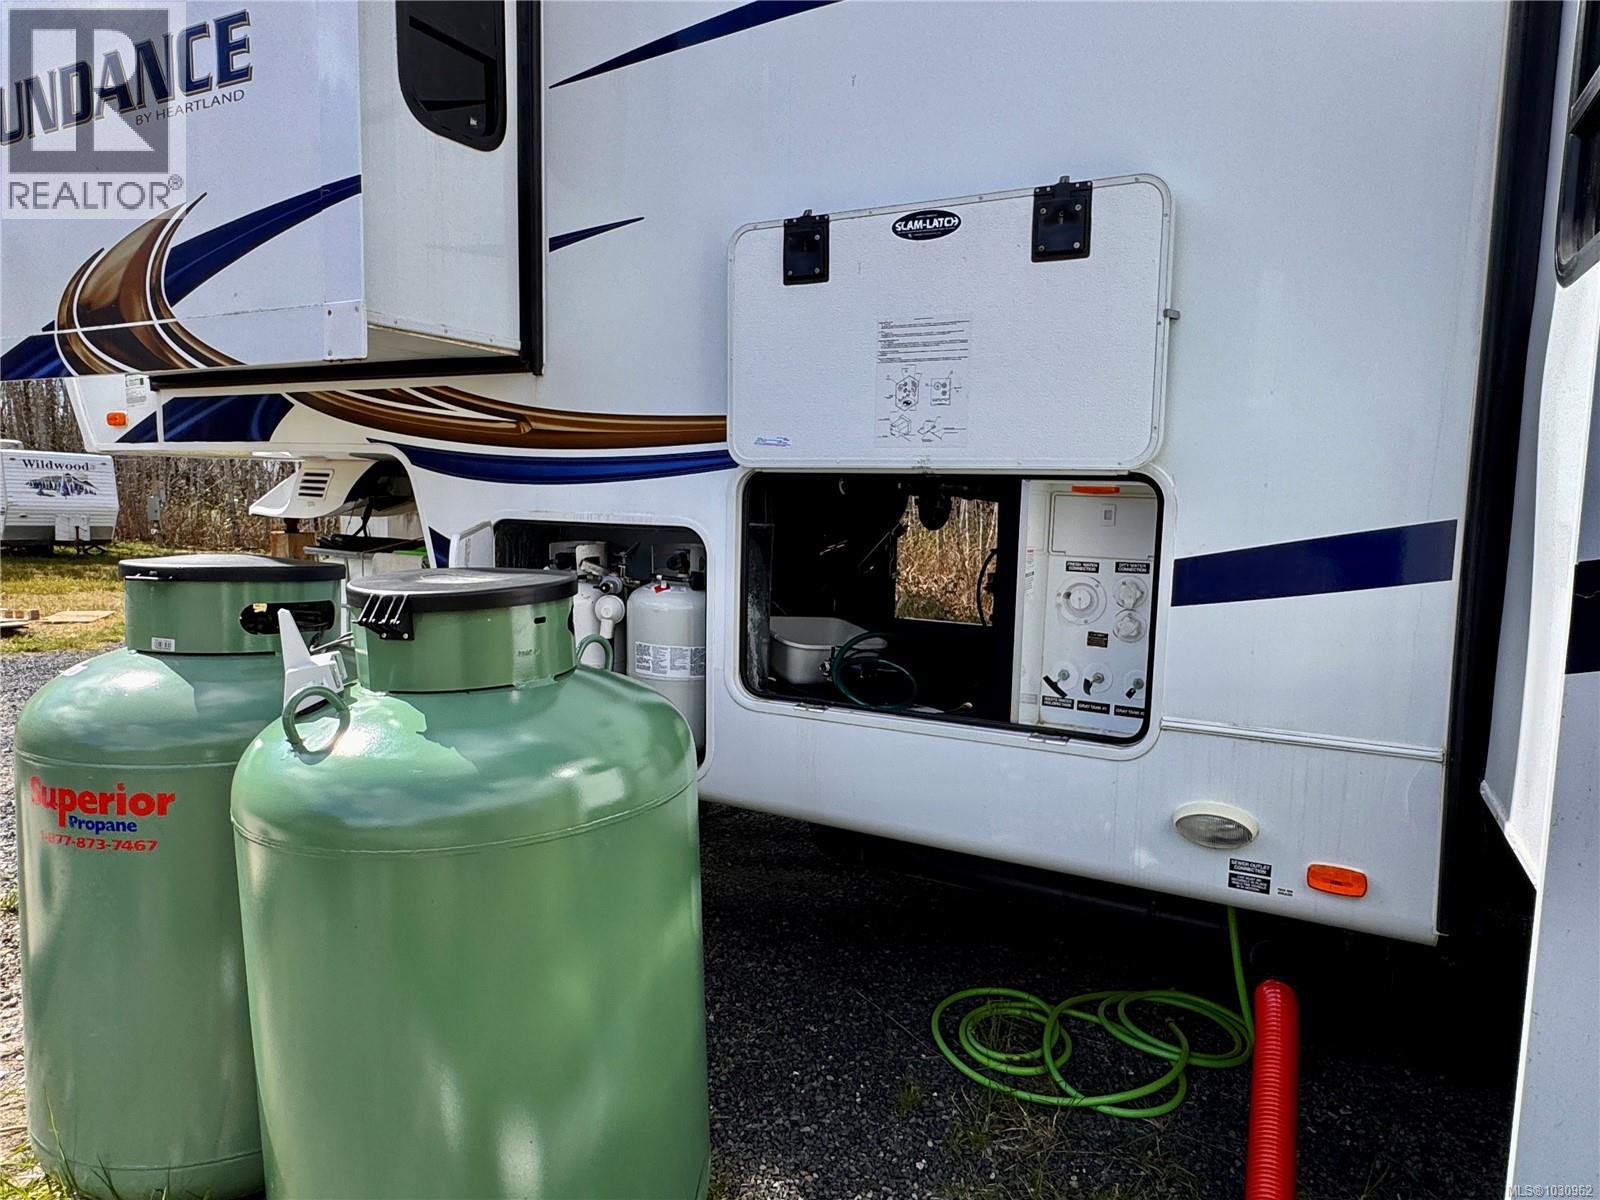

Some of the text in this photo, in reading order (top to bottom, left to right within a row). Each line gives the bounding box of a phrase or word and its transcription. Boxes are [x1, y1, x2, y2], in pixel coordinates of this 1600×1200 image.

[135, 89, 245, 126] BY HEARTLAND
[895, 216, 960, 232] SLAM-LATCH
[22, 459, 90, 471] Wildwood
[30, 776, 176, 827] Superior
[68, 815, 138, 835] Propane
